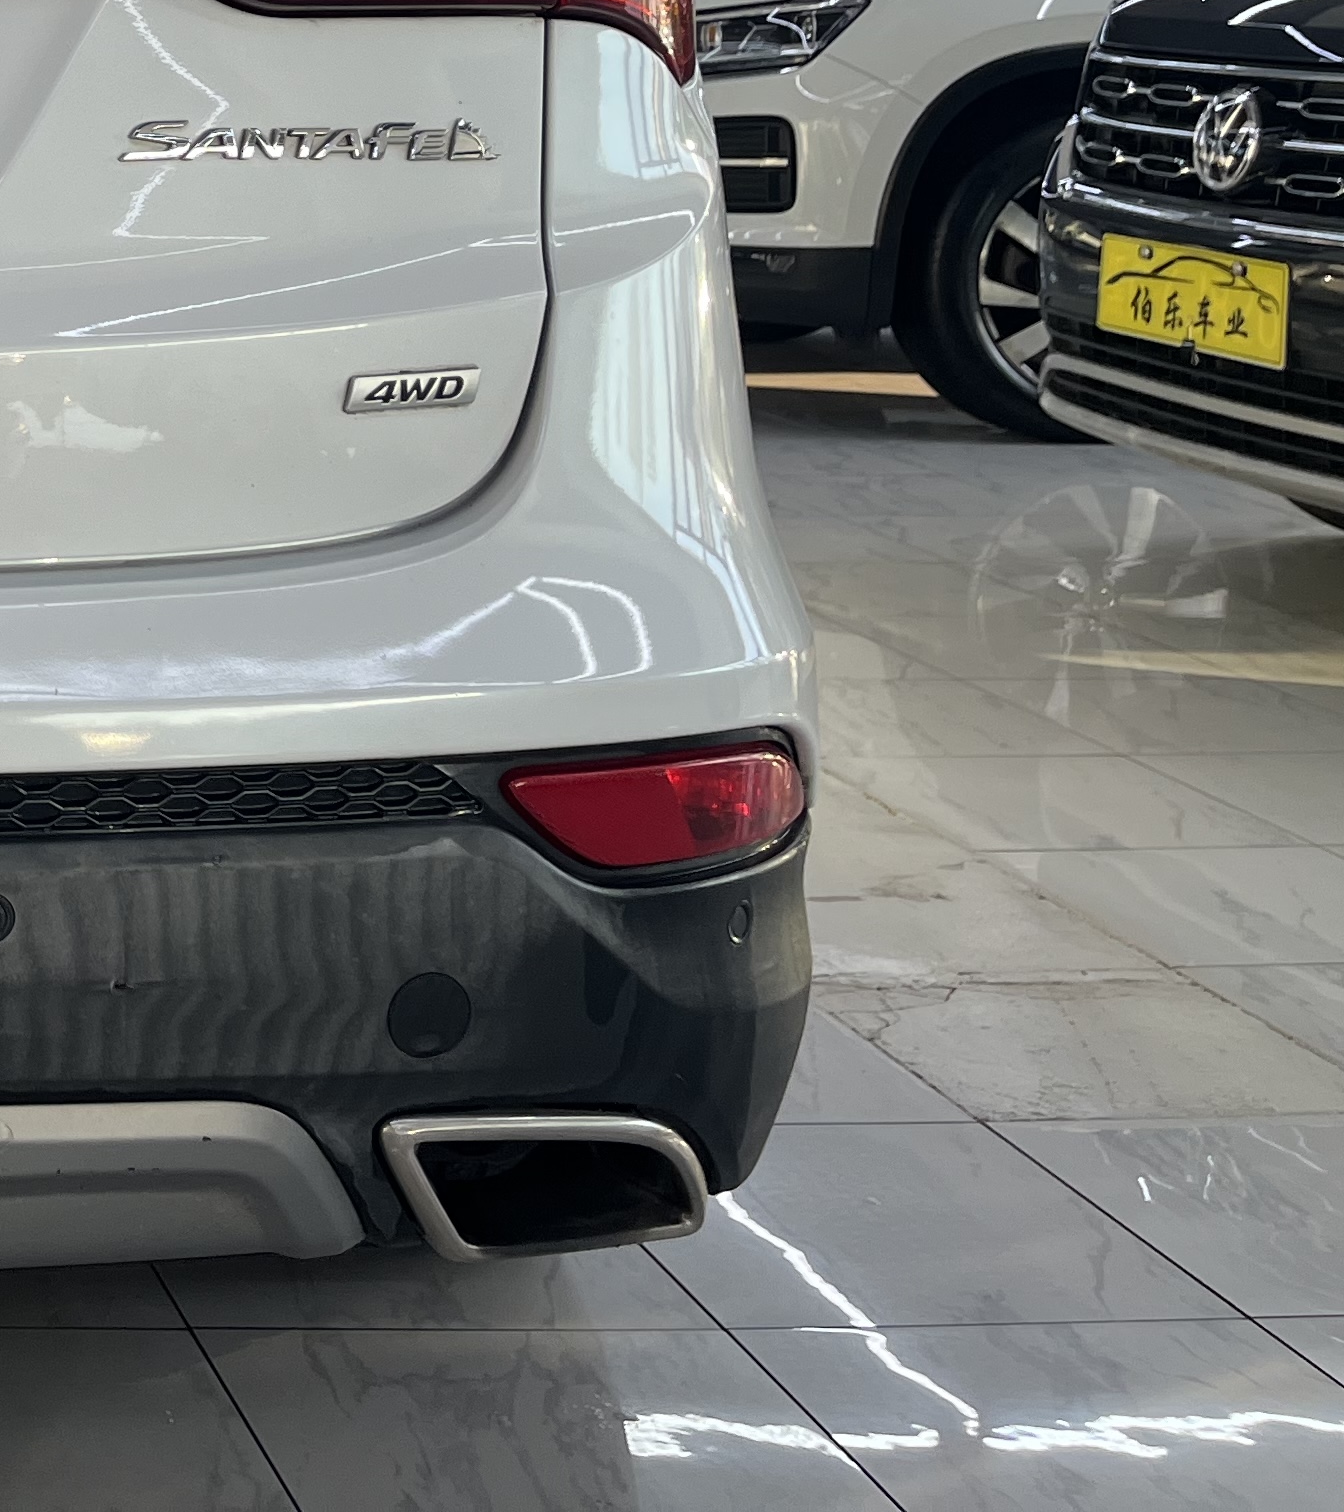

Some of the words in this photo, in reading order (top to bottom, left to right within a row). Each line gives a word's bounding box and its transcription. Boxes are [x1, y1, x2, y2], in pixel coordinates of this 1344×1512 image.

[1130, 285, 1249, 339] 伯乐车业
[363, 374, 466, 405] 4WD
